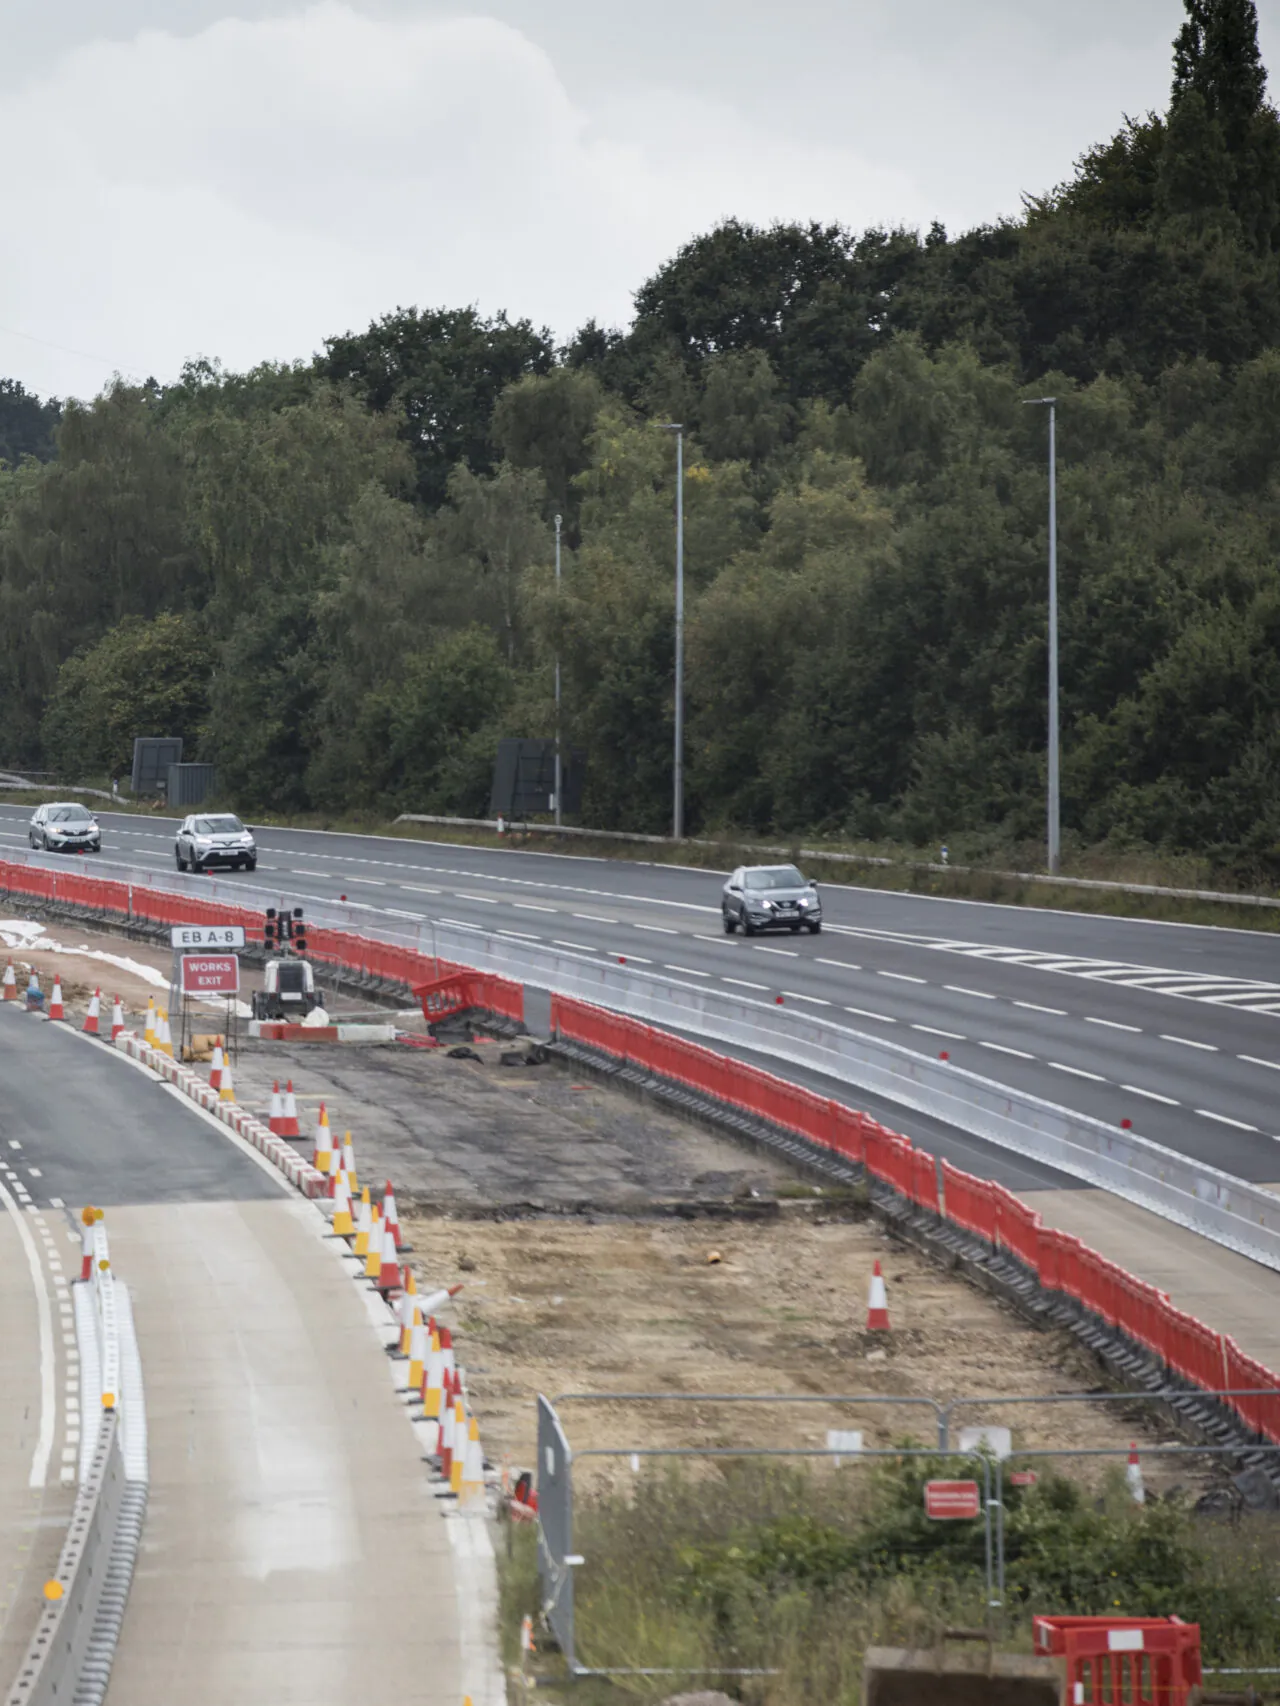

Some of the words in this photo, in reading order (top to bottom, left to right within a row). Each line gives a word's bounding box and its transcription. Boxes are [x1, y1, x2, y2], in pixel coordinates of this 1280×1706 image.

[182, 931, 202, 943] EB
[207, 931, 234, 943] A-8
[189, 962, 231, 972] WORKS
[198, 976, 223, 985] EXIT
